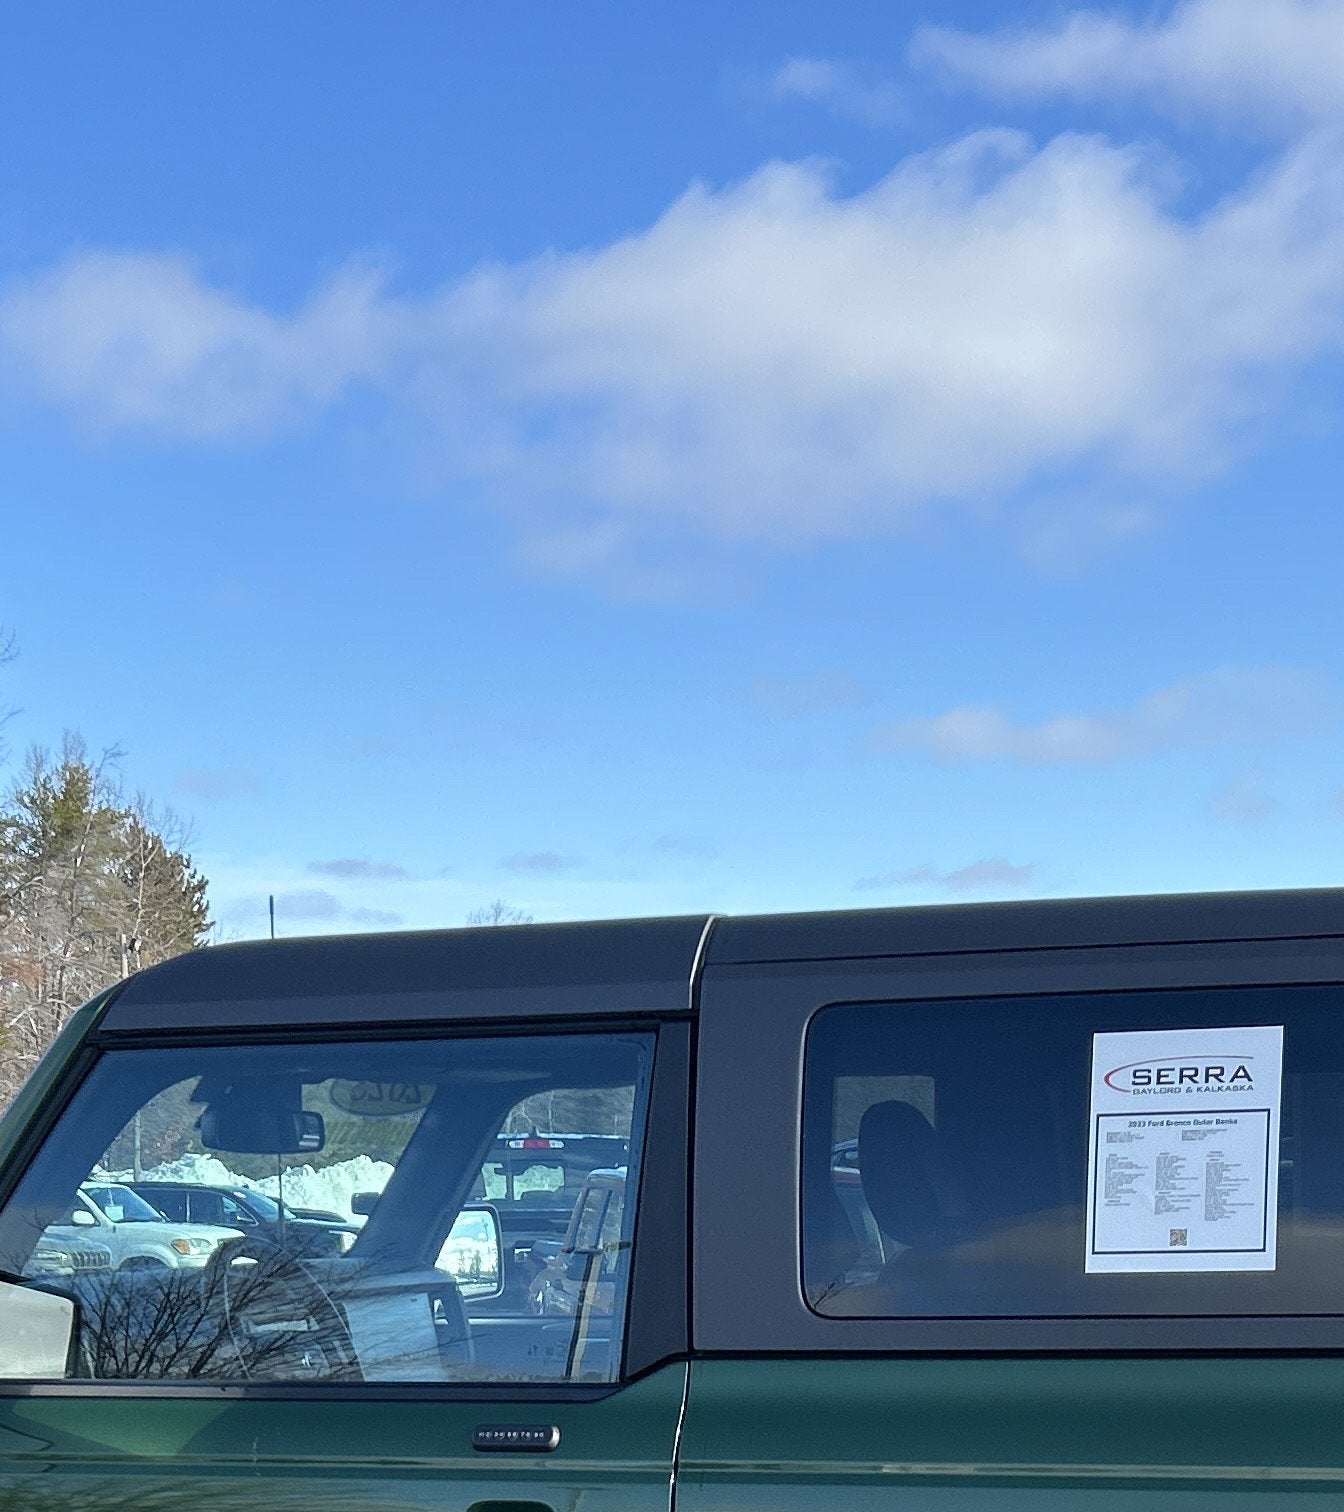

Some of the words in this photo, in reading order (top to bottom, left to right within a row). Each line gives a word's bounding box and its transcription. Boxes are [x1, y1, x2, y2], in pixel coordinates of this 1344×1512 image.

[1131, 1065, 1254, 1086] SERRA
[1133, 1087, 1182, 1096] GAYLORD
[1185, 1086, 1193, 1094] &
[1196, 1084, 1254, 1093] KALKASKA
